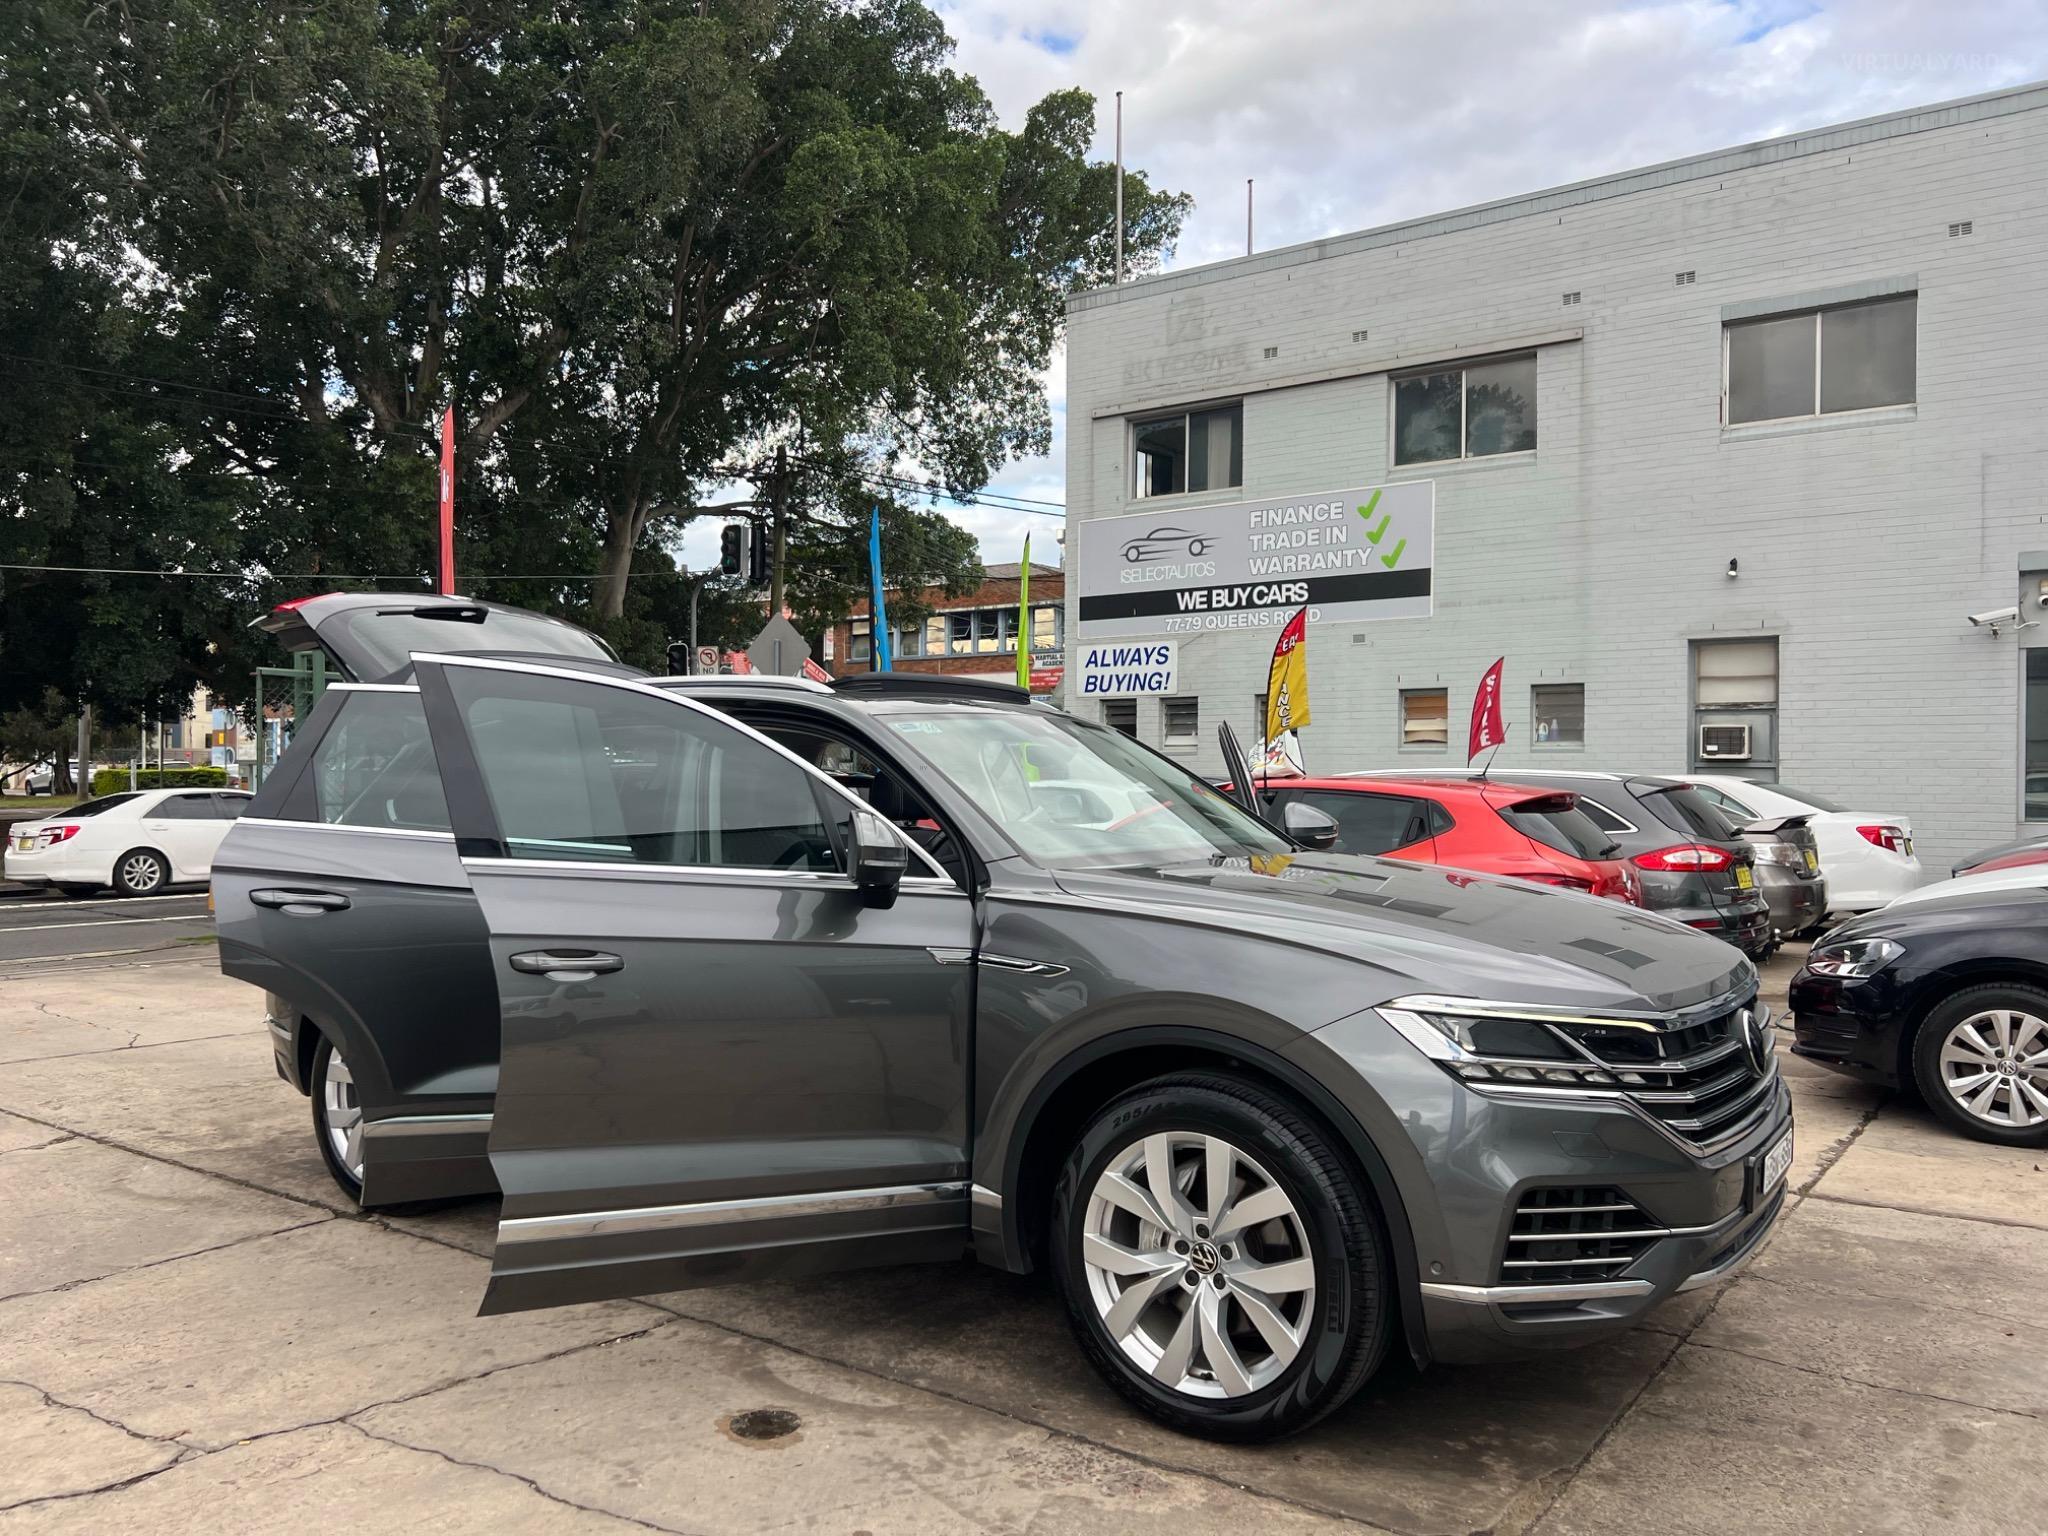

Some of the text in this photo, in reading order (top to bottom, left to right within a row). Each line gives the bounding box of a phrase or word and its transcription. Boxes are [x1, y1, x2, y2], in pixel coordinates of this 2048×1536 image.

[1249, 501, 1345, 529] FINANCE
[1248, 524, 1349, 553] TRADE IN
[1248, 547, 1373, 576] WARRANTY
[1176, 581, 1310, 611] WE BUY CARS
[1164, 607, 1322, 632] 77-79 QUEENS ROD
[1084, 645, 1171, 669] ALWAYS
[702, 667, 715, 675] NO
[1083, 671, 1172, 694] BUYING!
